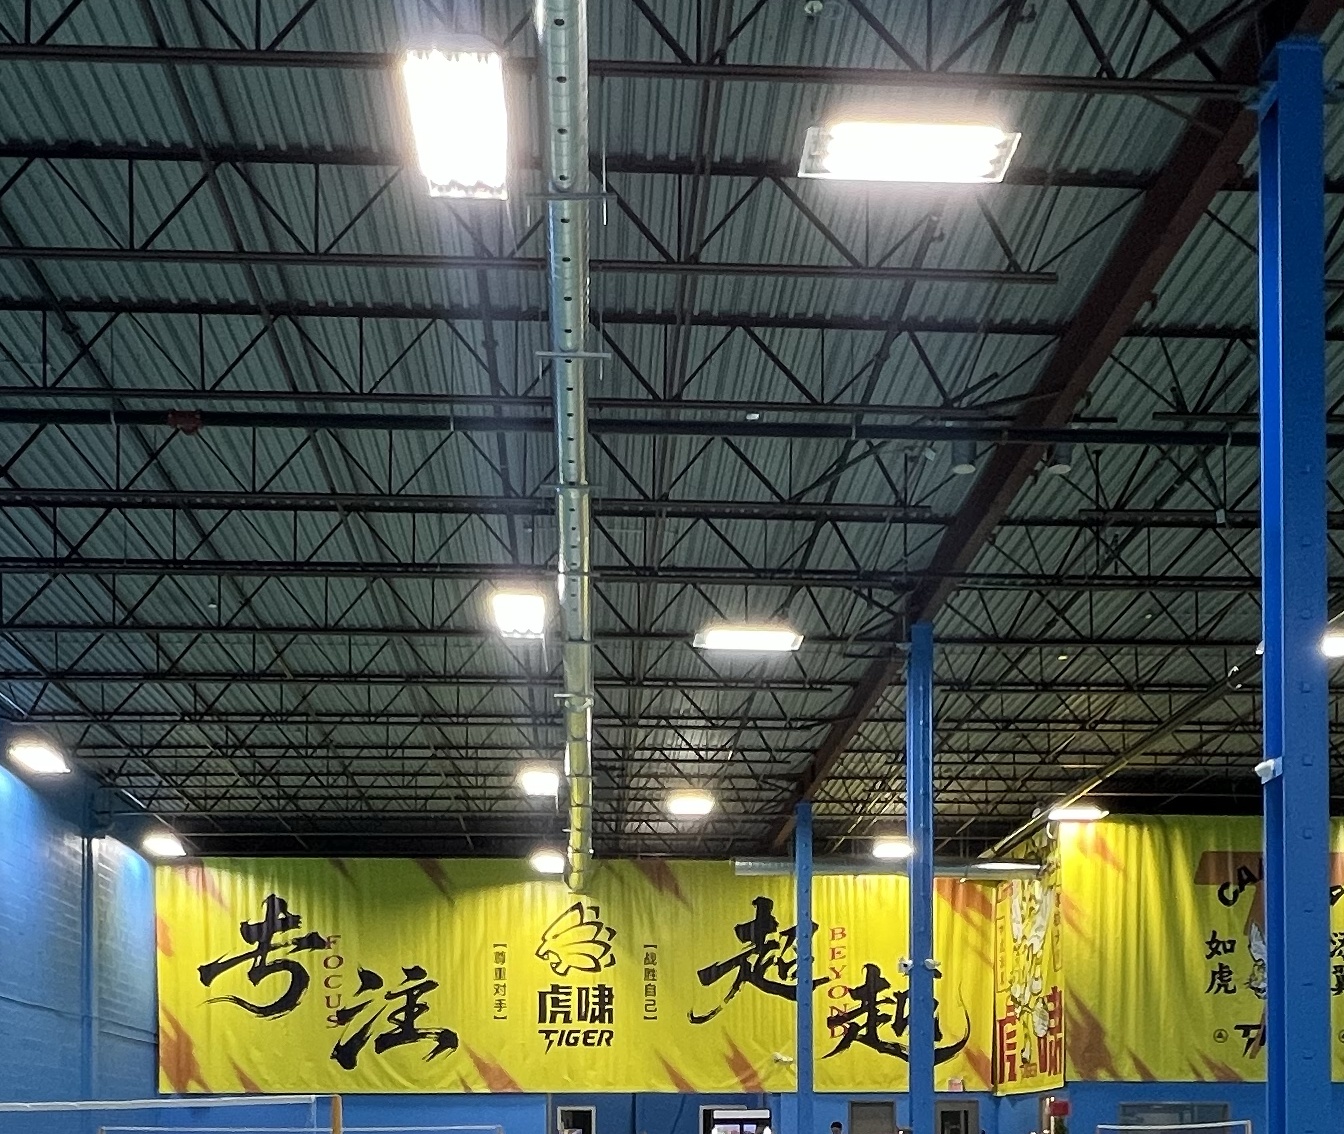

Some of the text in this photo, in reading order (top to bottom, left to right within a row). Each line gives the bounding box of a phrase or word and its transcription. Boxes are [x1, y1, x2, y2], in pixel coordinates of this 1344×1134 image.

[323, 935, 344, 1028] FOCUS
[827, 926, 849, 1039] BEYOND
[1205, 930, 1237, 995] 如虎
[537, 983, 615, 1025] 虎啸
[537, 1029, 615, 1055] TIGER
